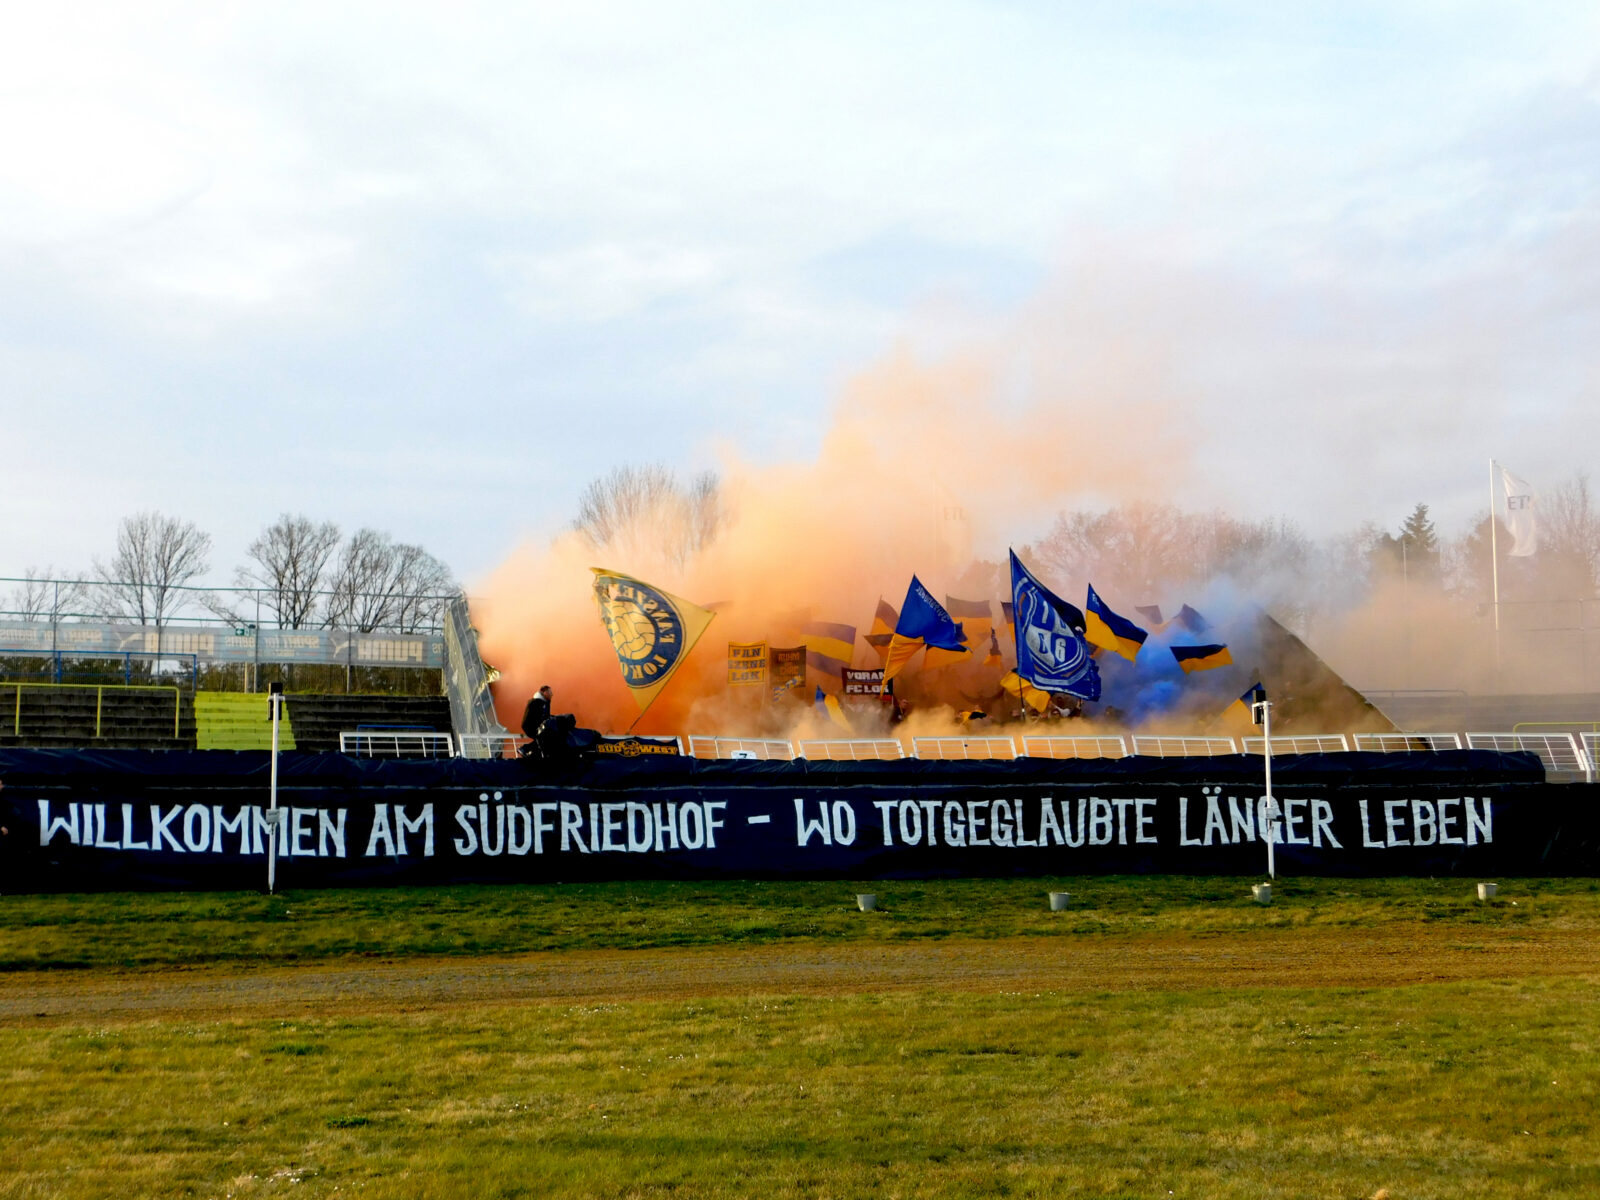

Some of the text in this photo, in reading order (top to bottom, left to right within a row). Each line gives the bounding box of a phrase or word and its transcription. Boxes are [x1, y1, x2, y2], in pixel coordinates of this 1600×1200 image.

[733, 648, 761, 658] FAN
[846, 685, 862, 694] FC
[38, 800, 347, 857] WILLKOMMEN
[365, 803, 434, 857] AM
[454, 791, 727, 856] SÜDFRIEDHOF
[794, 799, 856, 846] WO
[873, 797, 1158, 848] TOTGEGLAUBTE
[1179, 786, 1344, 848] LÄNGER
[1359, 797, 1493, 849] LEBEN
